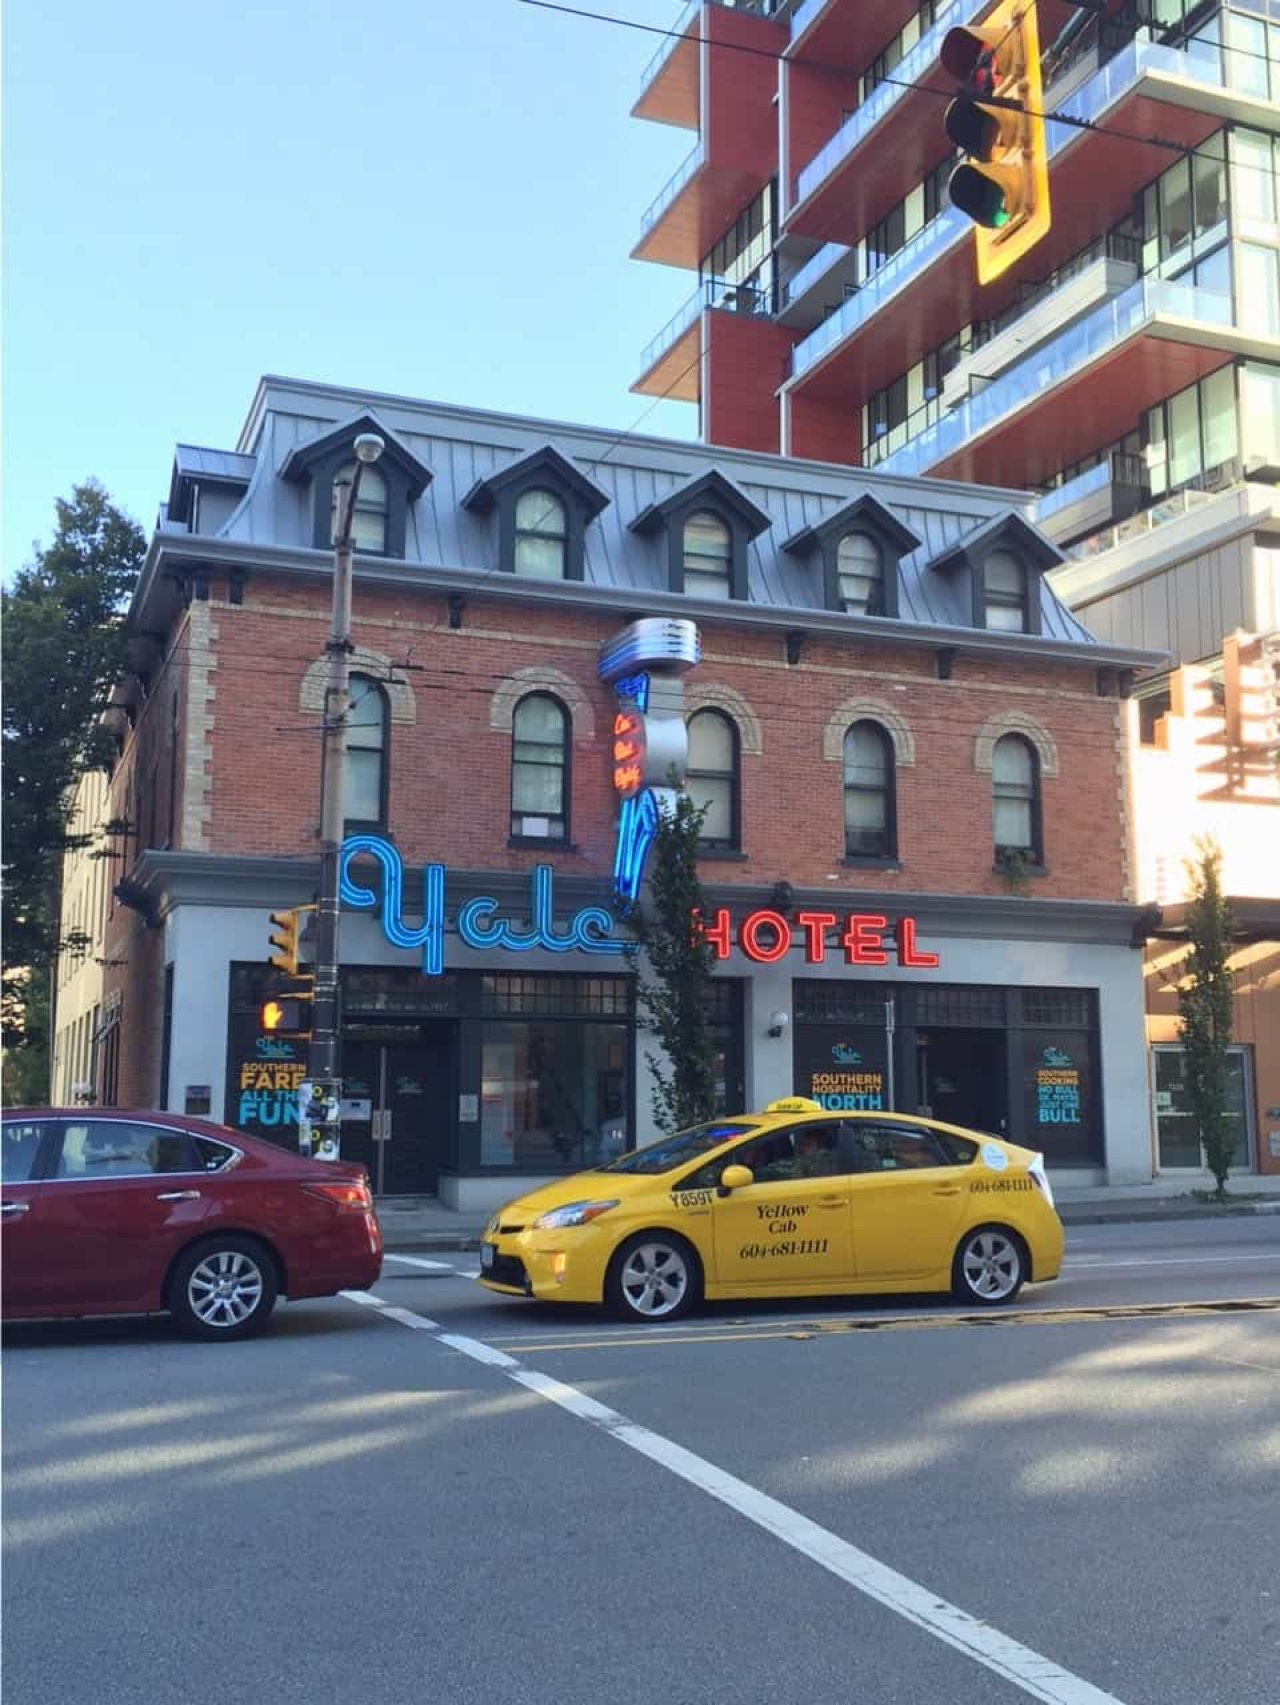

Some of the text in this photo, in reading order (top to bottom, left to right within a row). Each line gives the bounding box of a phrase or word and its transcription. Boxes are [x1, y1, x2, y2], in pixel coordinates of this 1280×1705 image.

[340, 836, 638, 975] Yale
[690, 908, 939, 968] HOTEL
[243, 1063, 306, 1073] SOUTHERN
[240, 1072, 306, 1089] FARE
[812, 1073, 882, 1085] SOUTHERN
[241, 1090, 300, 1102] ALL TH
[812, 1084, 882, 1094] HOSPITALITY
[812, 1093, 883, 1110] NORTH
[238, 1101, 301, 1126] FUN
[1039, 1108, 1081, 1122] BULL
[757, 1203, 810, 1219] Yellow
[768, 1219, 798, 1234] Cab
